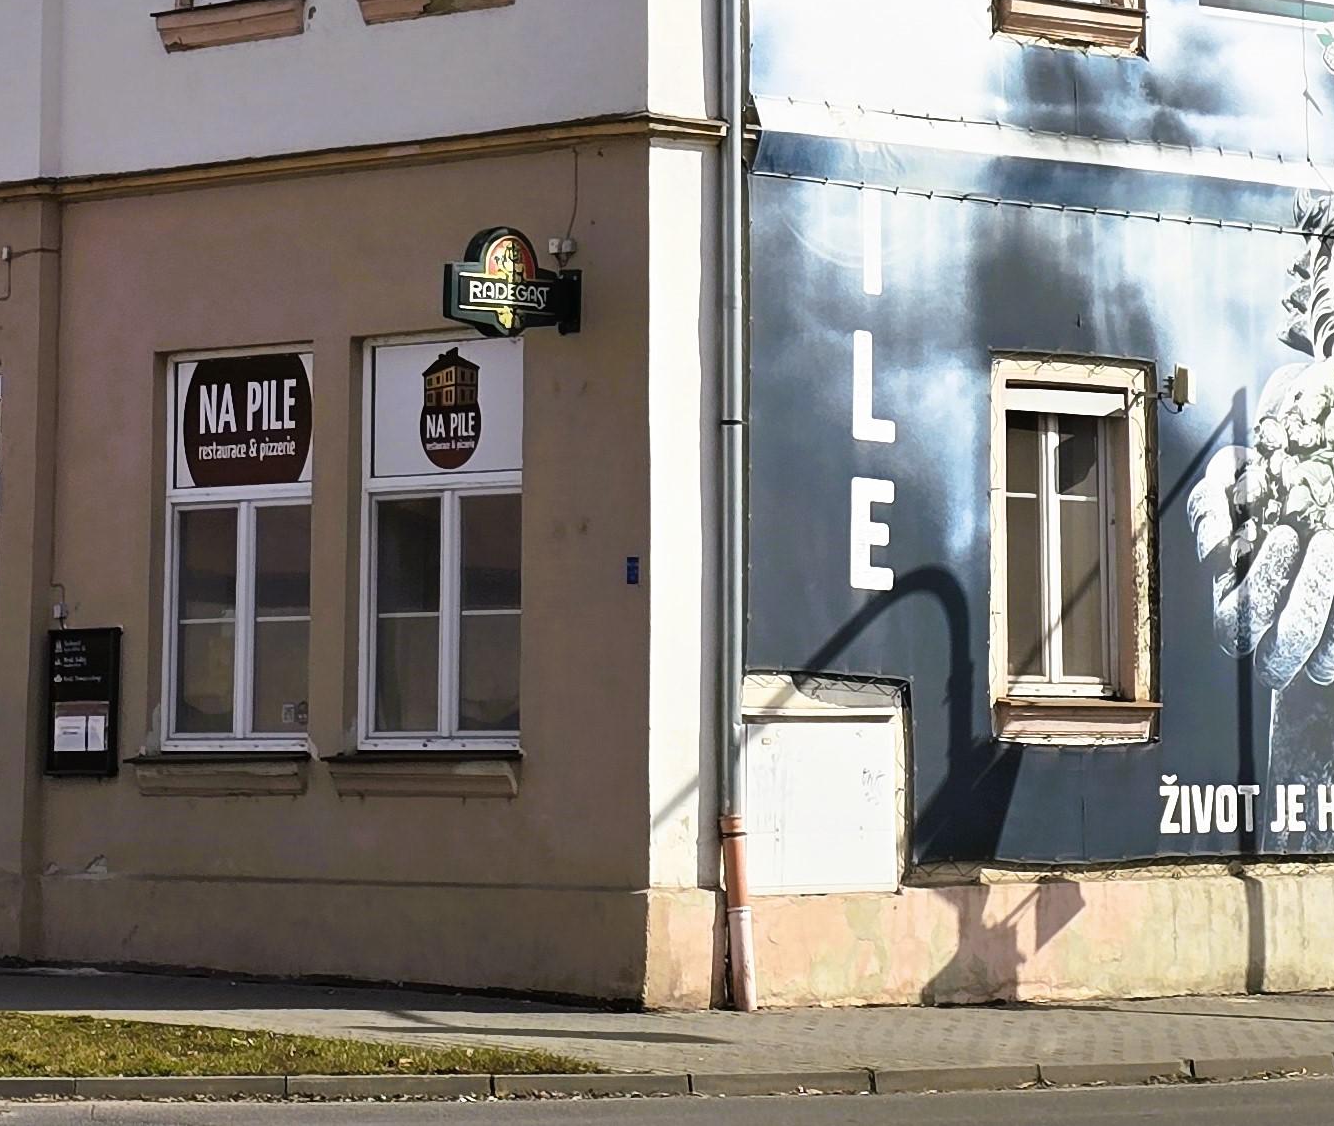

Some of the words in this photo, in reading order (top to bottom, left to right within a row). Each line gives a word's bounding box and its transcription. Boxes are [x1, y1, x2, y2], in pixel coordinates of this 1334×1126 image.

[469, 280, 550, 310] RADEGAST
[199, 382, 237, 435] NA
[247, 378, 297, 432] PILE
[426, 413, 446, 439] NA
[450, 412, 476, 437] PILE
[198, 441, 247, 461] restaurace
[248, 438, 258, 458] &
[259, 435, 296, 462] pizzerie
[1159, 774, 1260, 834] ŽIVOT
[1270, 784, 1306, 832] JE
